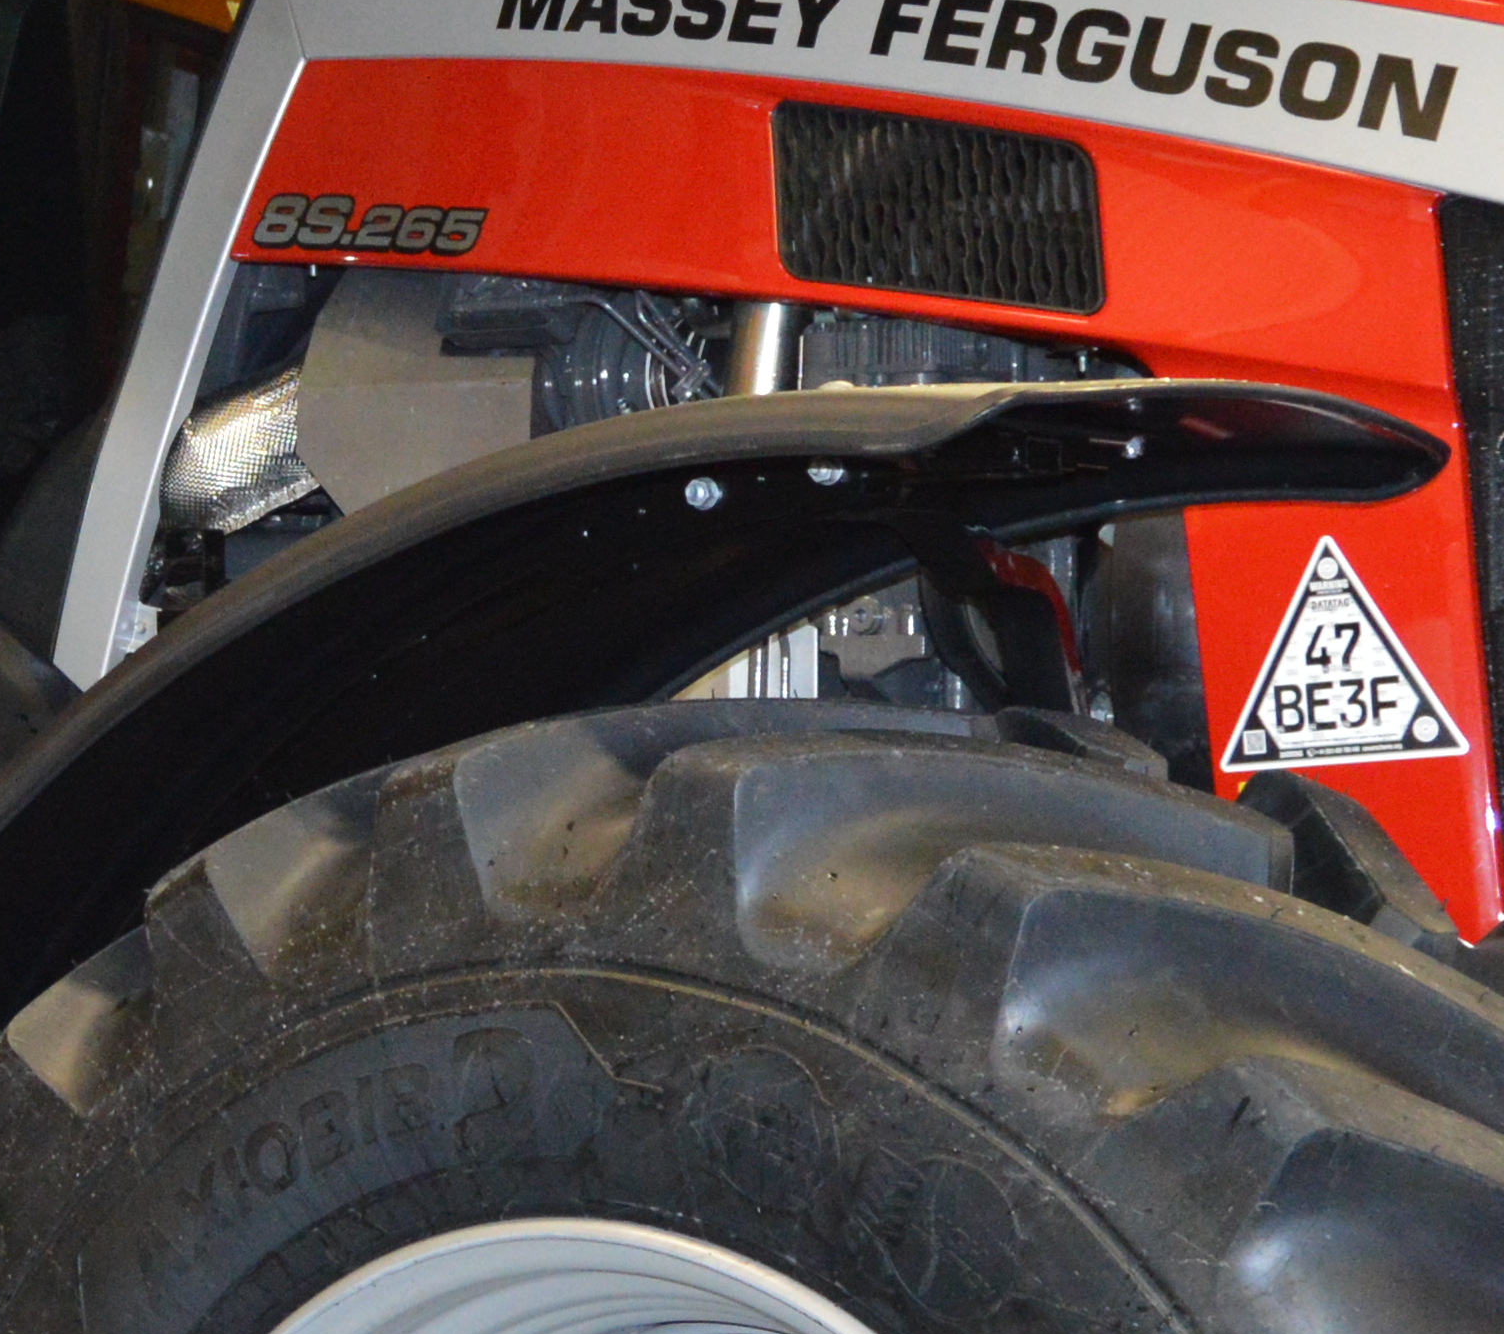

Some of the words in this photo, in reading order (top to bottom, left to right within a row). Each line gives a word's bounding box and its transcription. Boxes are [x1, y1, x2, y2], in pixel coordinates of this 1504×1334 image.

[252, 193, 489, 256] 8S.265
[1305, 622, 1361, 672] 47
[1274, 675, 1399, 733] BE3F
